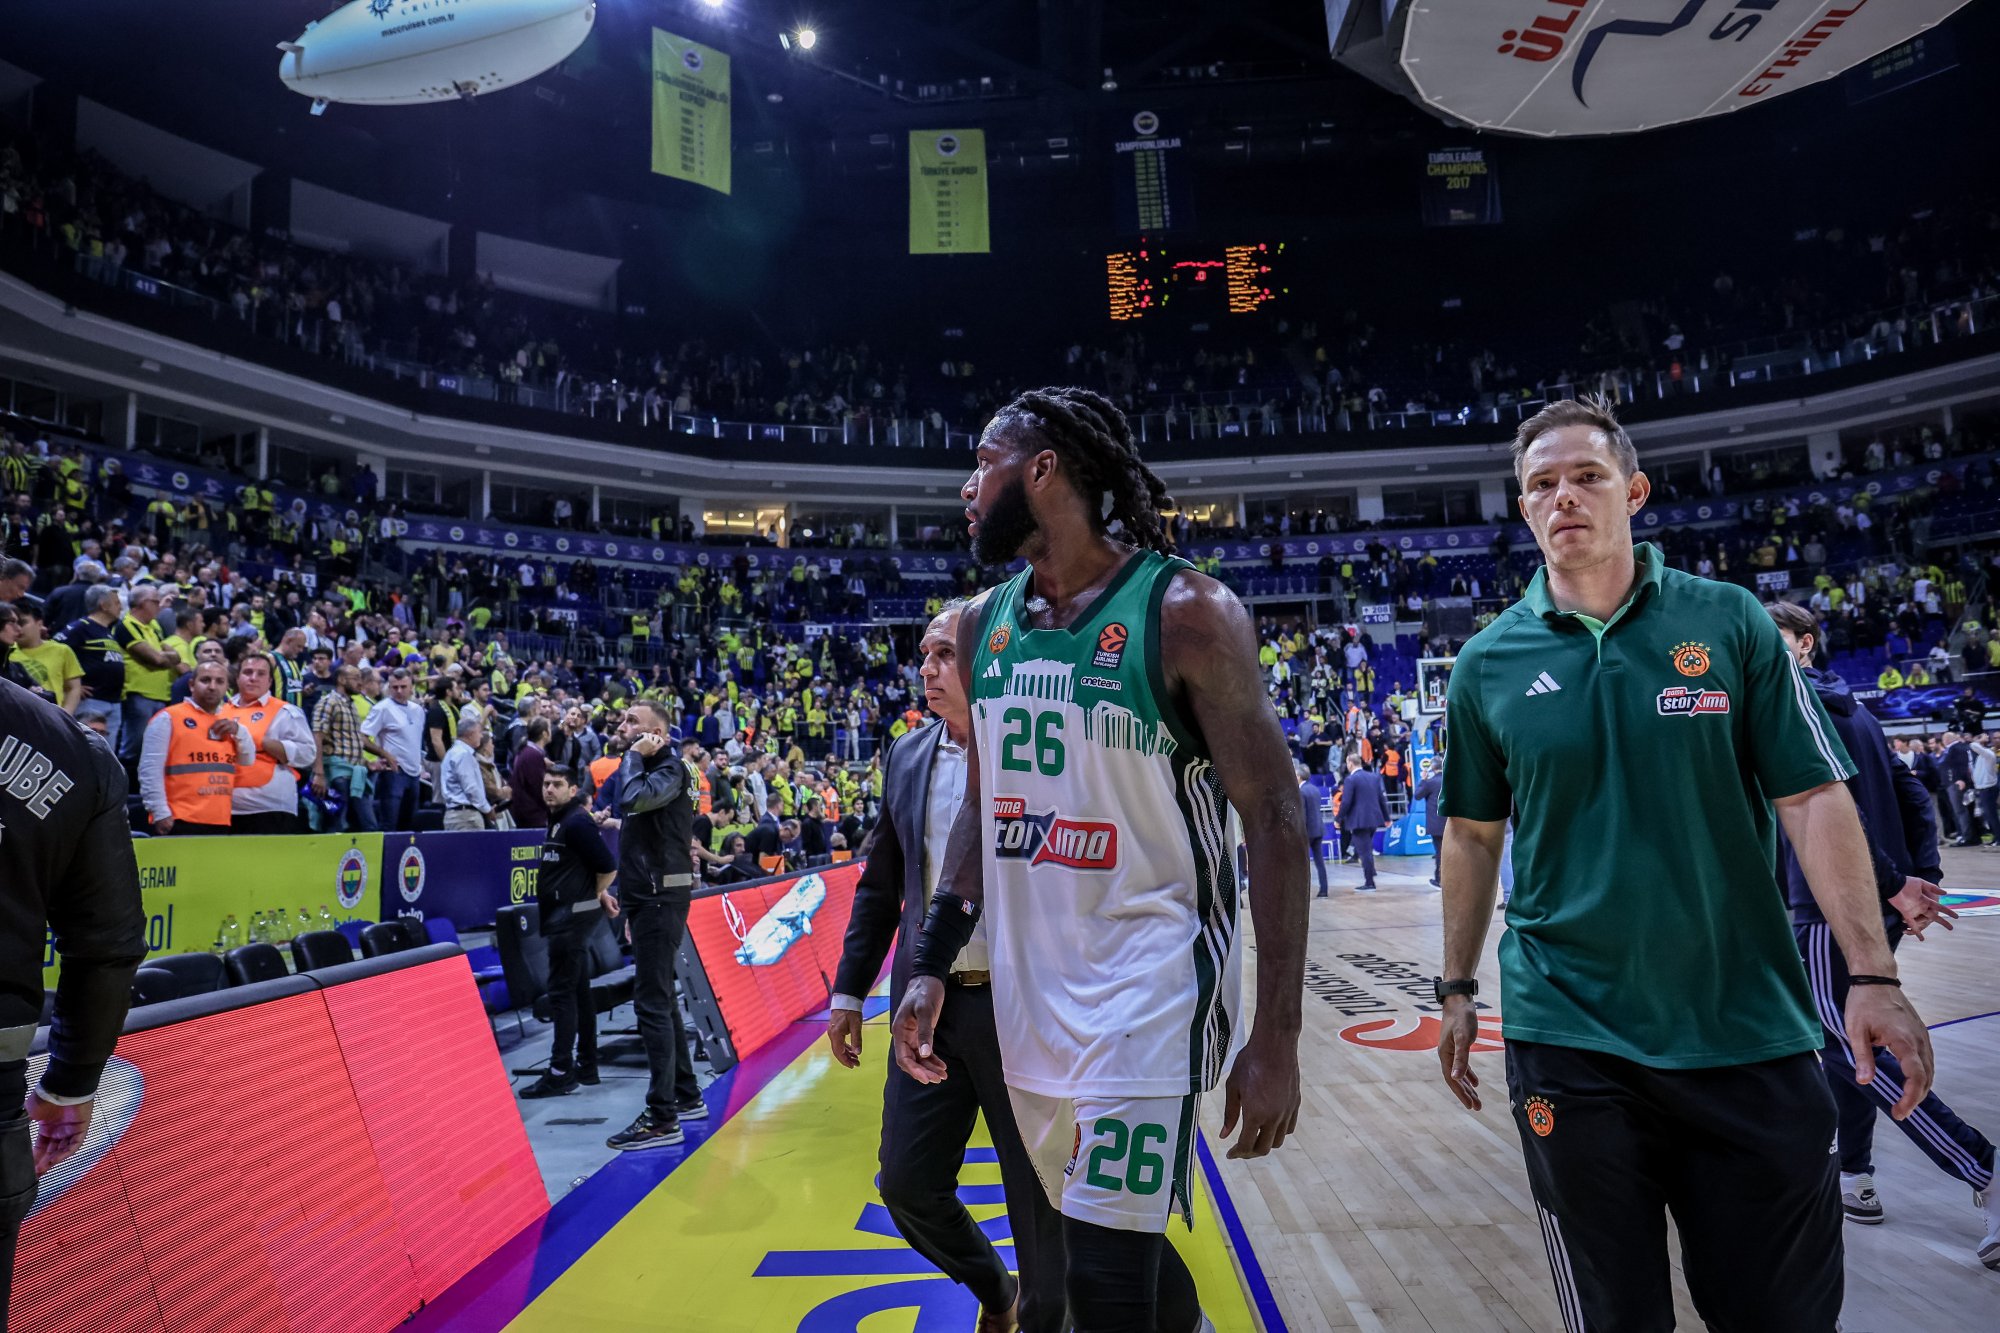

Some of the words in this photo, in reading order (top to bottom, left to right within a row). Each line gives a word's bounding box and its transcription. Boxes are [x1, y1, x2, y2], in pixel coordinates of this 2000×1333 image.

[1498, 0, 1588, 62] ÜL
[1428, 151, 1483, 163] EUROLEAGUE
[1427, 162, 1487, 176] CHAMPIONS
[1446, 177, 1470, 189] 2017
[439, 377, 455, 388] 412
[764, 427, 780, 436] 411
[1095, 655, 1119, 664] AIRLINES
[1096, 650, 1120, 659] TURKISH
[1002, 707, 1065, 777] 26
[139, 866, 176, 889] GRAM
[1086, 1117, 1167, 1195] 26
